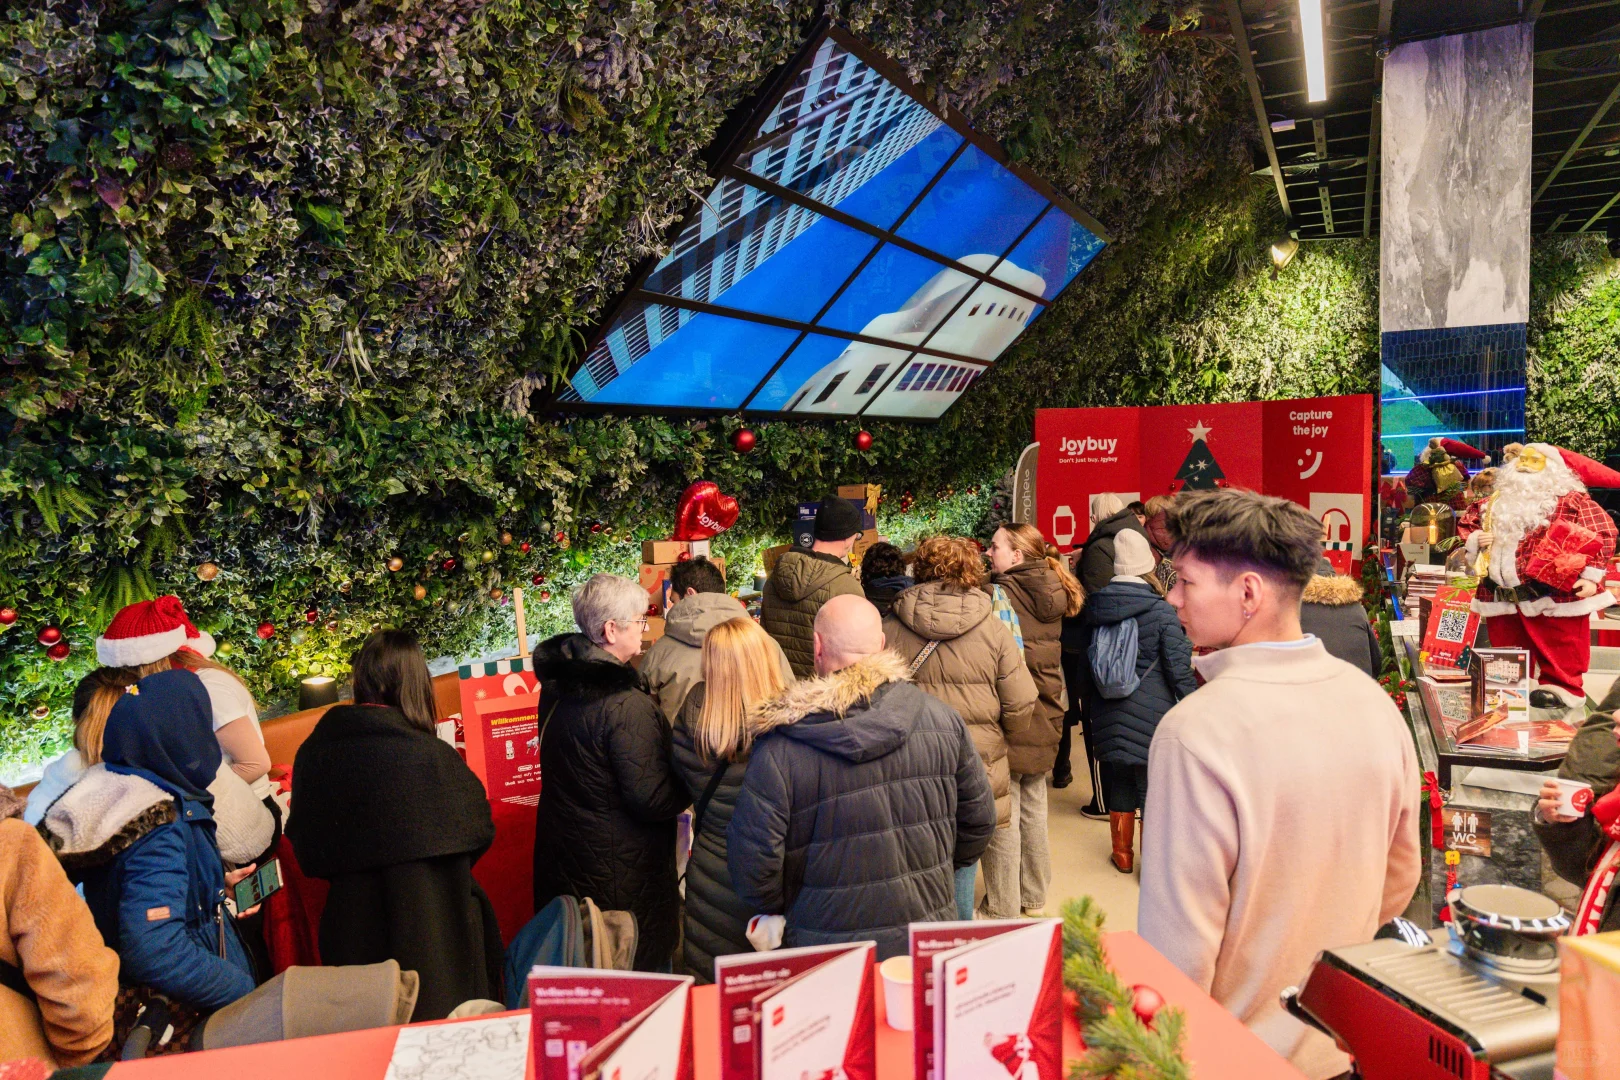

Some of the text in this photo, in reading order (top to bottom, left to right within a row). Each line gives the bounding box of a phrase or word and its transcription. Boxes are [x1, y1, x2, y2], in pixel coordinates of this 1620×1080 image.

[1289, 410, 1333, 424] Capture
[1293, 424, 1329, 438] the joy
[1059, 436, 1118, 456] Joybuy
[491, 714, 535, 726] Willkommen
[1452, 831, 1476, 844] WC
